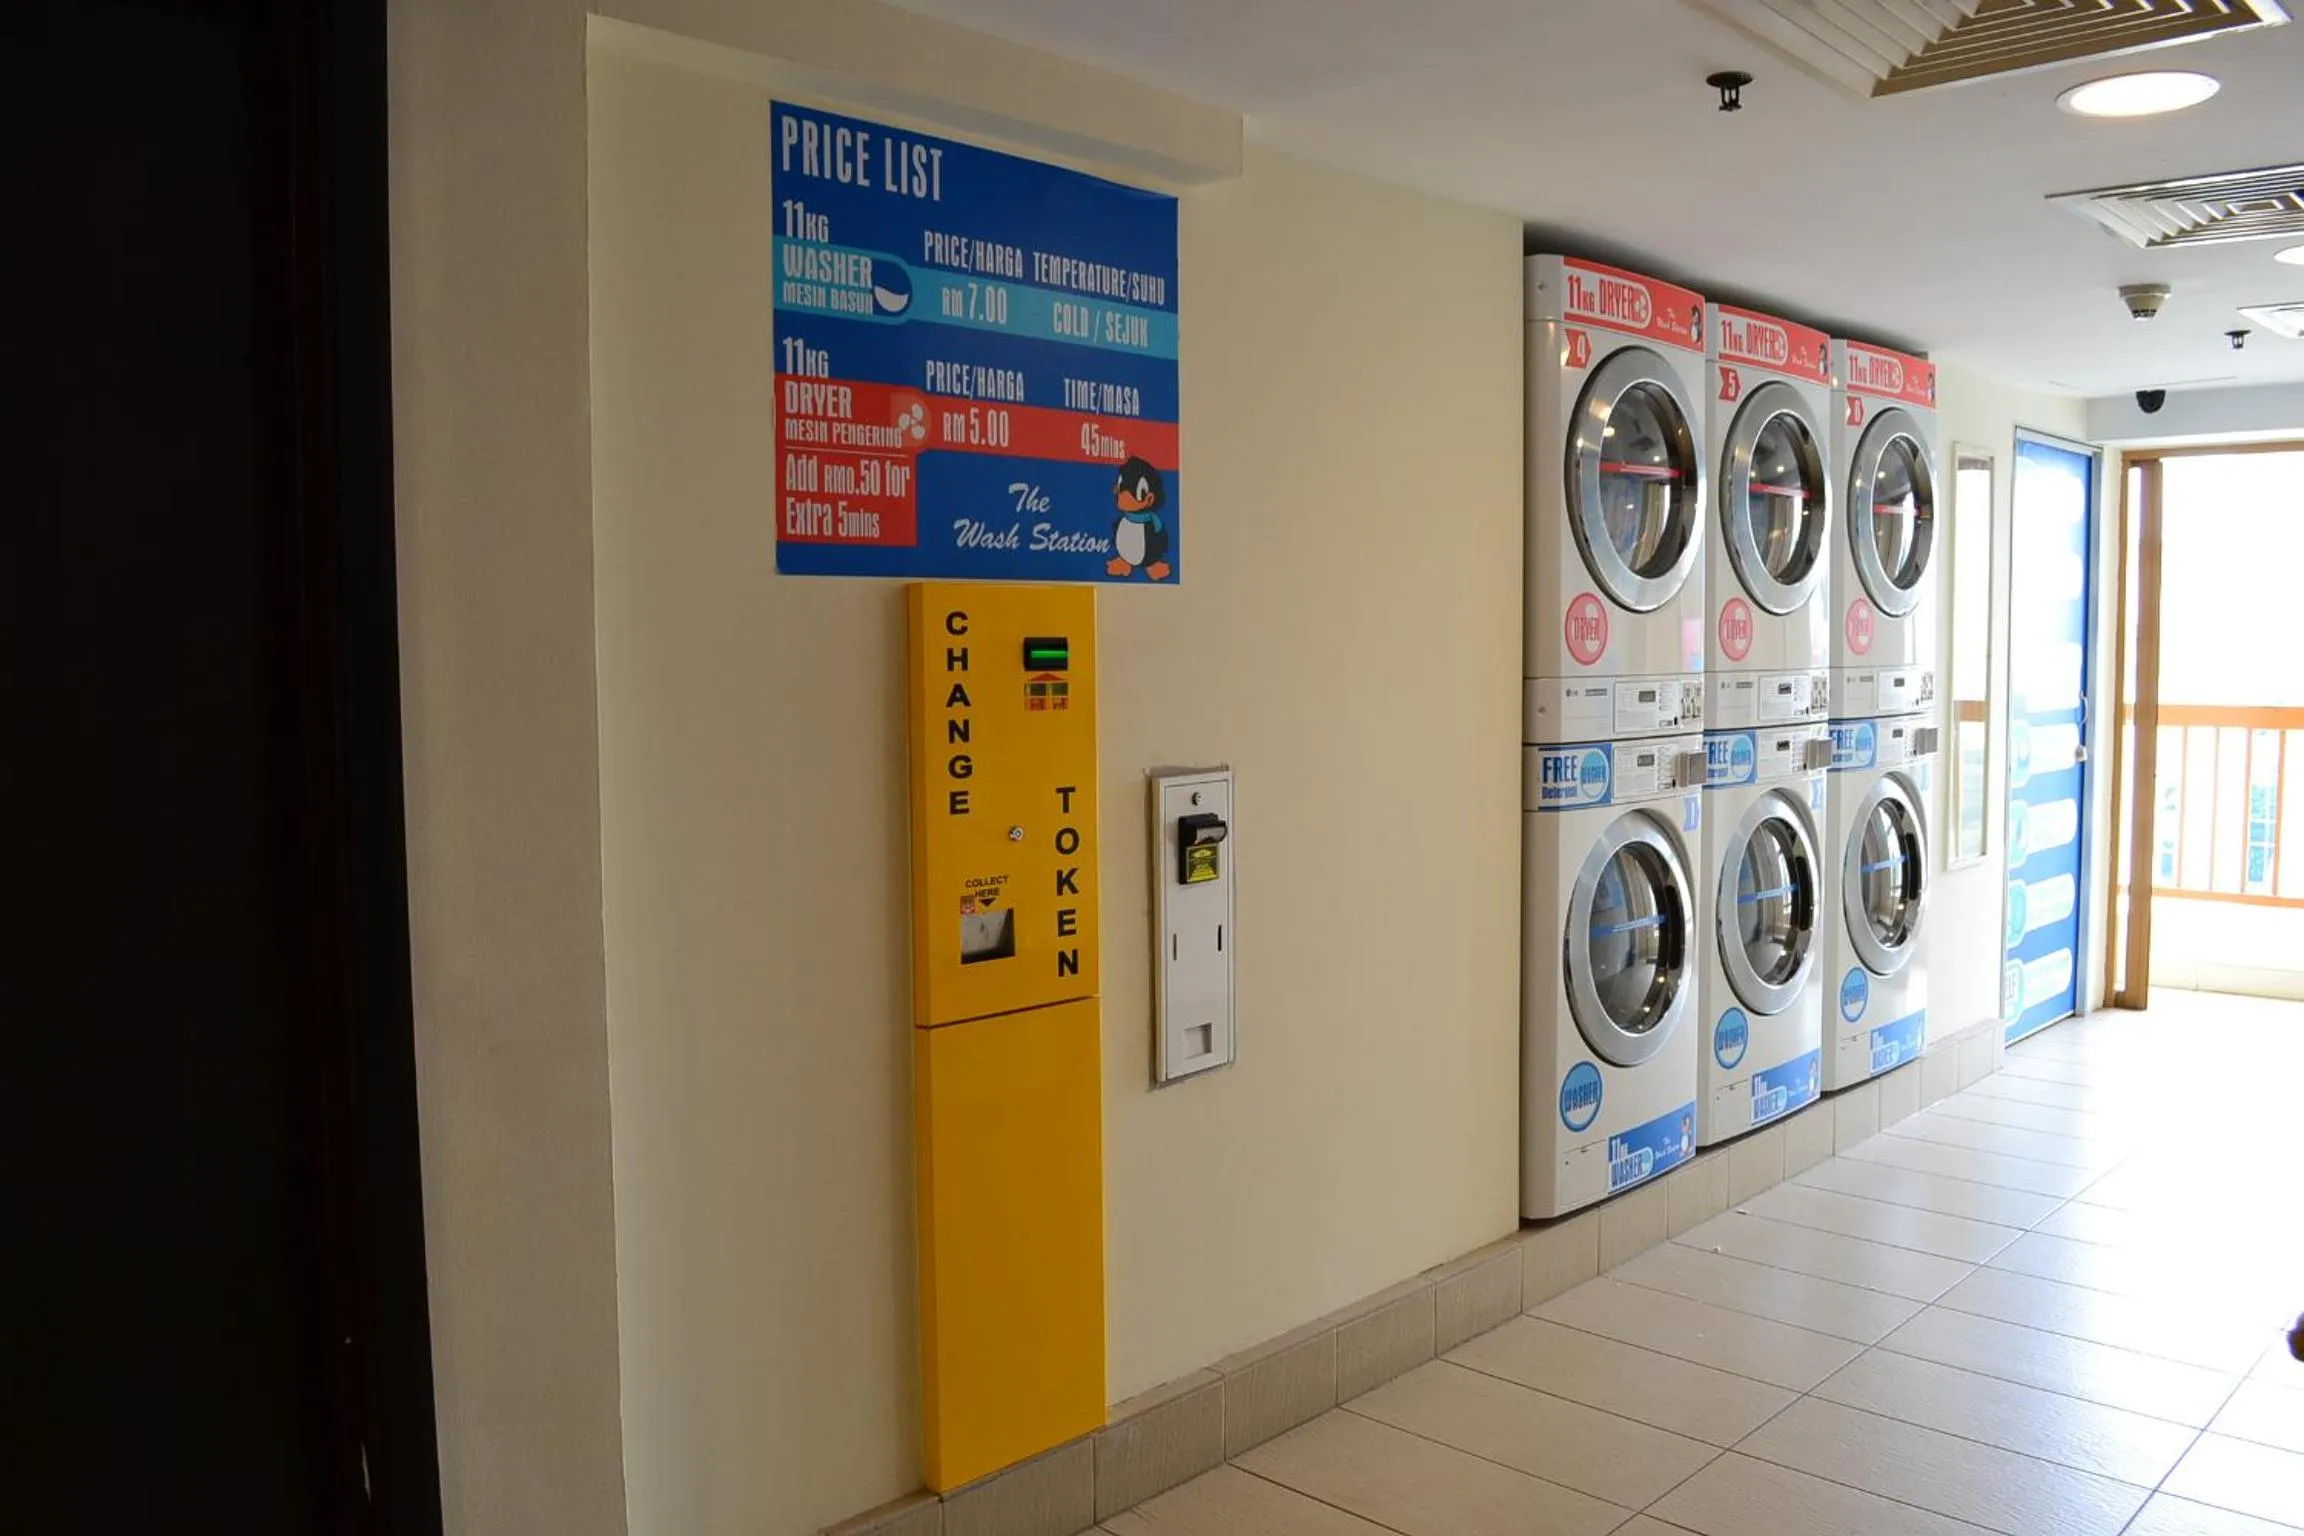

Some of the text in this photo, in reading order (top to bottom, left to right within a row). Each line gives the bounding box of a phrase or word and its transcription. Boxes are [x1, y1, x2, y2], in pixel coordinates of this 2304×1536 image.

[782, 115, 943, 201] PRICE LIST
[782, 199, 829, 243] 11KG
[783, 243, 873, 289] WASHER
[924, 231, 1165, 306] PRICE/HARGA TEMPERATURE/SUHU
[783, 281, 874, 316] MESIN BASUH
[942, 282, 1007, 325] RM 7.00
[1599, 278, 1634, 322] DRYER
[1053, 301, 1089, 338] COLD
[1105, 310, 1149, 349] SEJUK
[1746, 321, 1776, 360] DRYER
[783, 336, 829, 379] 11KG
[785, 380, 852, 418] DRYER
[926, 360, 1140, 417] PRICE/HARGA TIME/MASA
[785, 417, 903, 449] MESIN PENGERING
[943, 406, 1009, 448] RM 5.00
[786, 453, 818, 492] Add
[884, 460, 910, 498] for
[786, 496, 880, 539] Extra 5mins
[1008, 483, 1051, 513] The
[953, 518, 1110, 553] Wash Station
[1573, 615, 1600, 642] DRYER
[946, 611, 973, 815] CHANGE
[1543, 755, 1578, 784] FREE
[965, 875, 1009, 889] COLLECT
[975, 887, 1000, 898] HERE
[1055, 786, 1080, 977] TOKEN
[1564, 1081, 1599, 1112] WASHER
[1611, 1153, 1643, 1187] WASHER
